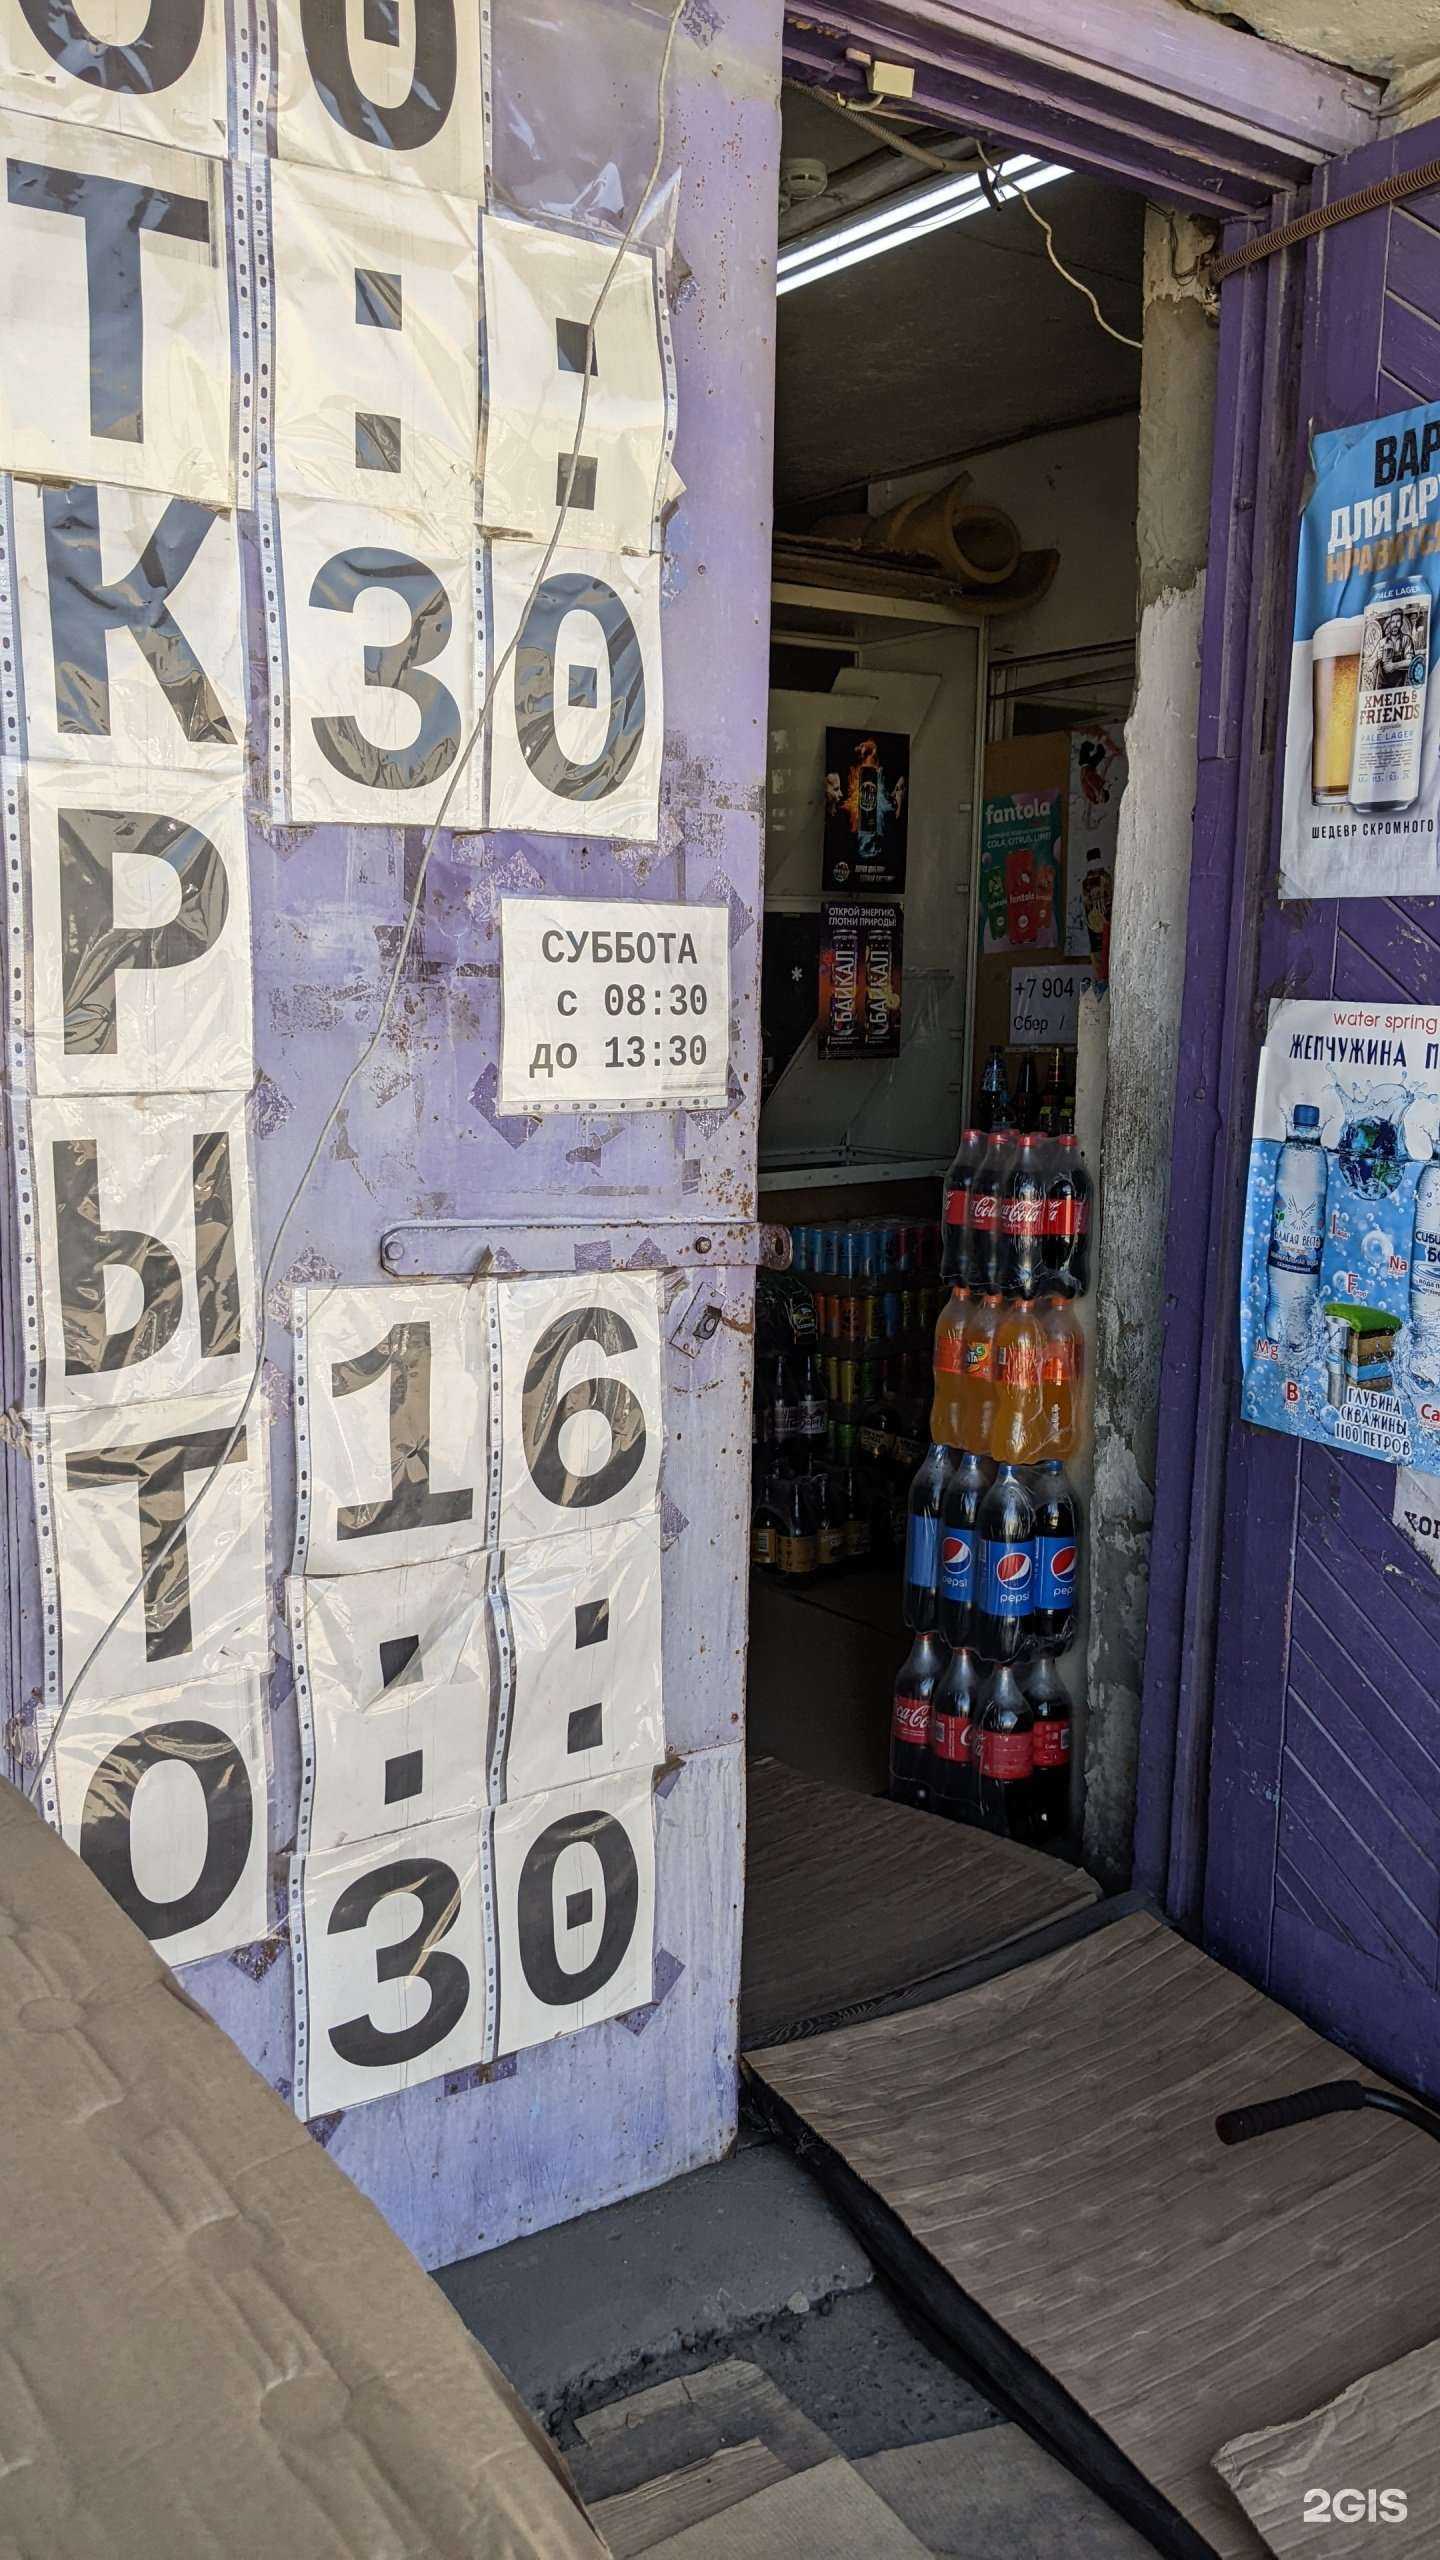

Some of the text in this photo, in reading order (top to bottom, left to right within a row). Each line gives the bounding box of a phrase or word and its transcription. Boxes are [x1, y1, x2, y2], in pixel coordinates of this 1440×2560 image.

[1328, 474, 1440, 554] ДЛЯ ДР
[1364, 692, 1410, 708] ХМЕЛЬ
[1360, 704, 1420, 725] FRIENDS
[985, 798, 1051, 824] fantola
[1312, 819, 1434, 839] ШЕДЕВР СКРОМНОГО
[829, 906, 859, 917] ОТКРОЙ
[829, 917, 858, 926] ГЛОТНИ
[541, 930, 698, 964] СУББОТА
[833, 950, 854, 1023] БАЙКАЛ
[1015, 978, 1036, 998] +7
[1042, 977, 1074, 998] 904
[604, 984, 708, 1016] 08:30
[1013, 1015, 1048, 1033] Сбер
[1334, 1011, 1438, 1034] water spring
[604, 1035, 707, 1068] 13:30
[1289, 1034, 1407, 1067] ЖЕМЧУЖИНА
[1390, 1255, 1408, 1270] Na
[1347, 1273, 1358, 1293] F
[1256, 1339, 1279, 1360] Mg
[1347, 1388, 1402, 1415] ГЛУБИНА
[1340, 1406, 1408, 1437] СКВАЖИНЫ
[1421, 1403, 1440, 1422] Ca
[1335, 1423, 1360, 1442] 1100
[1000, 1593, 1031, 1604] pepsi
[1053, 1586, 1074, 1597] pep
